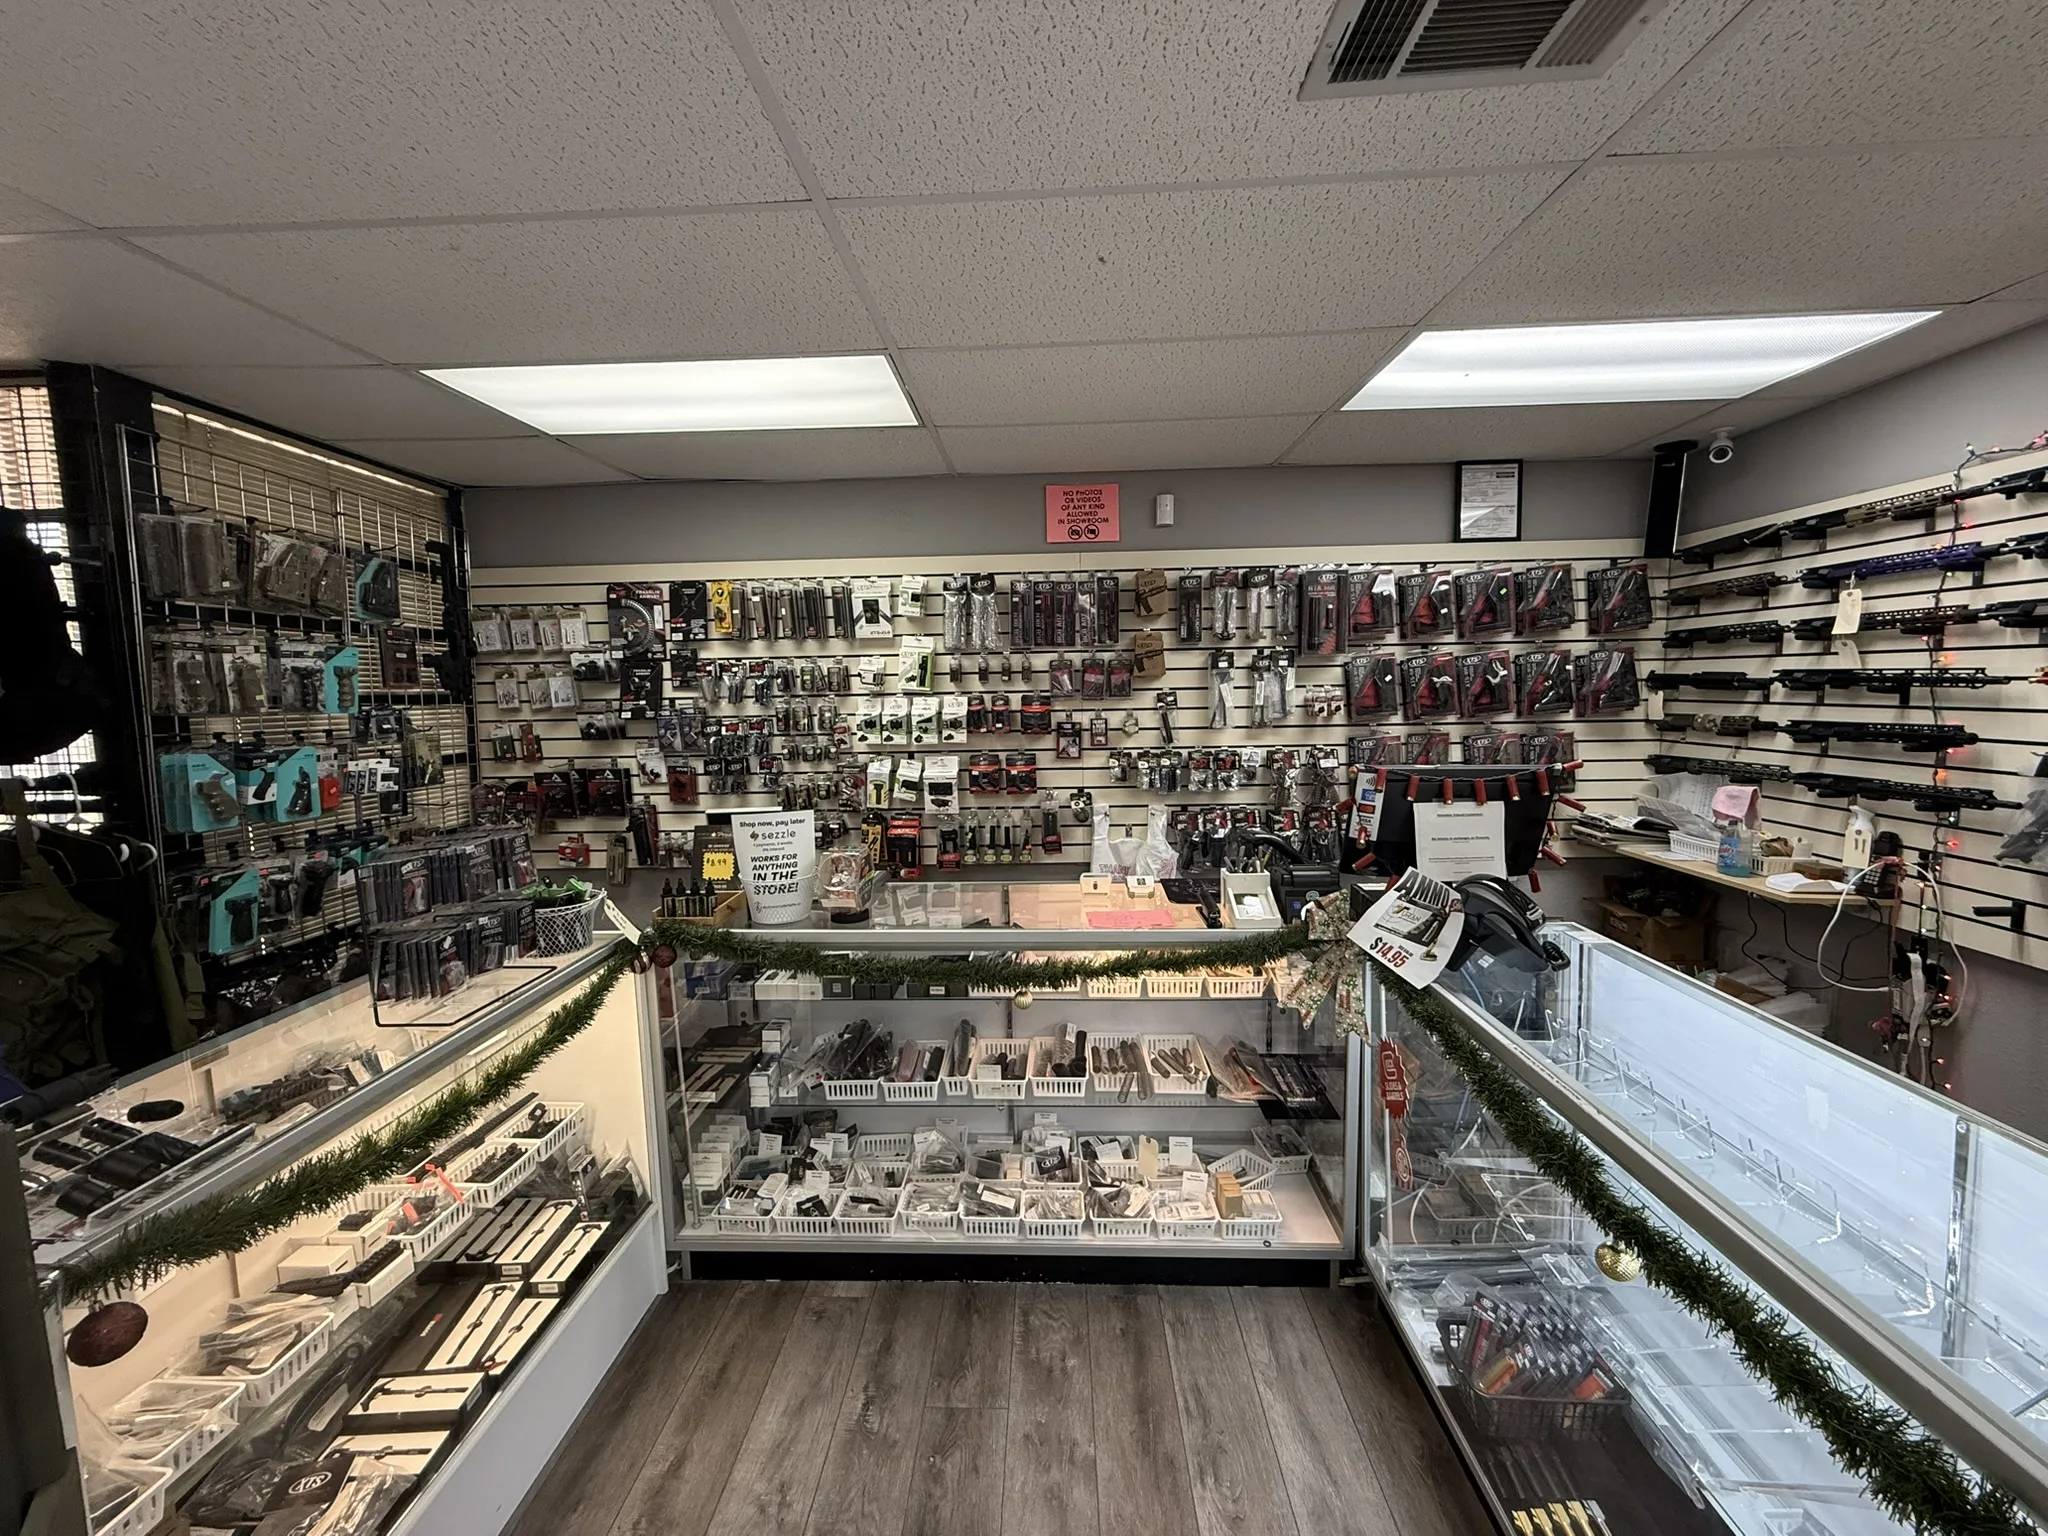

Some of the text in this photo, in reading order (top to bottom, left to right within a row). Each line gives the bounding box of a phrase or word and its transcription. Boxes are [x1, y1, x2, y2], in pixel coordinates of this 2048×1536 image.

[761, 829, 796, 840] sezzle
[750, 855, 780, 863] WORKS
[752, 861, 798, 871] ANYTHING
[753, 870, 798, 881] IN THE
[754, 882, 799, 896] STORE!
[1393, 869, 1450, 909] AMMO
[1370, 936, 1409, 968] $14.95
[292, 1473, 328, 1493] XTS
